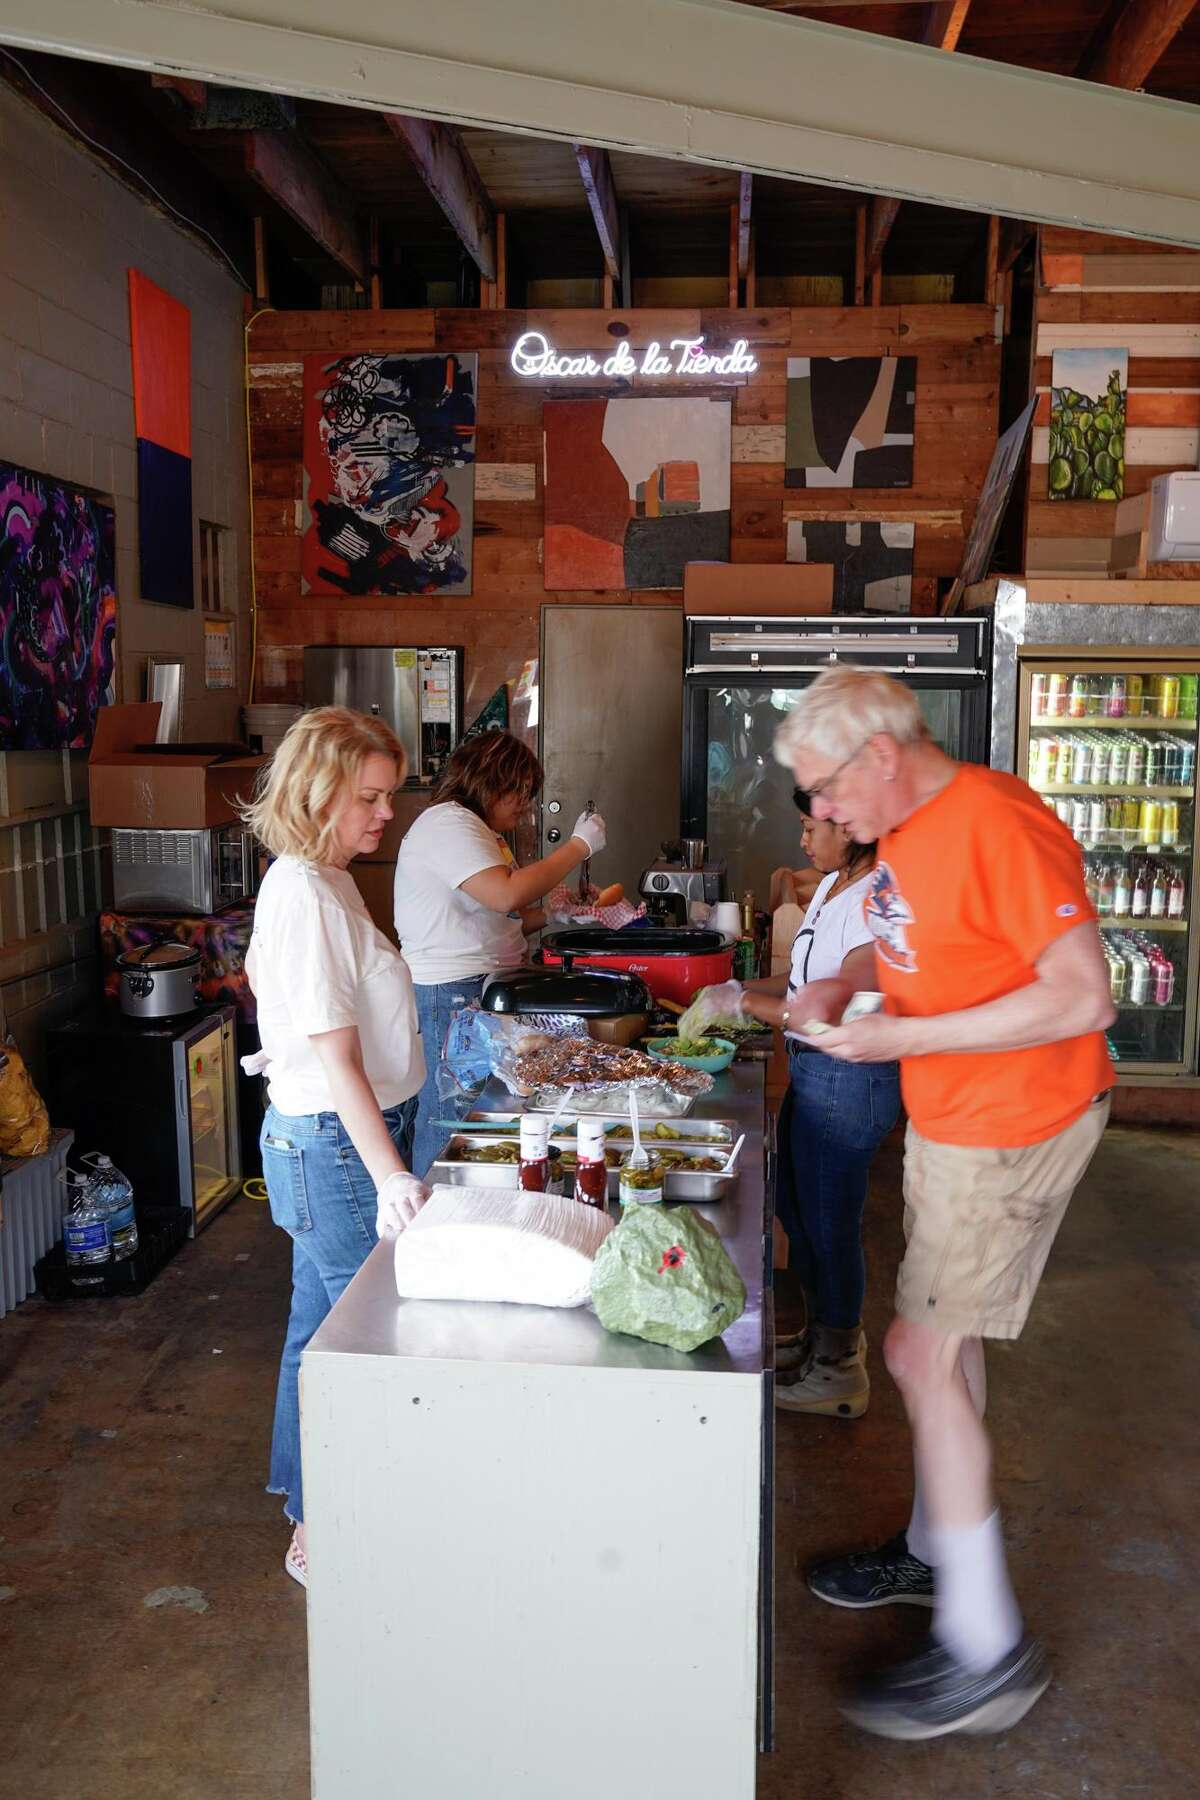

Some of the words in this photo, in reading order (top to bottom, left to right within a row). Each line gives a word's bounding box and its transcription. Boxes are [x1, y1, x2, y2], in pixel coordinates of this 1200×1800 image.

[511, 332, 600, 376] Oscar
[603, 341, 637, 375] de
[640, 341, 671, 375] la
[671, 336, 758, 374] Tienda
